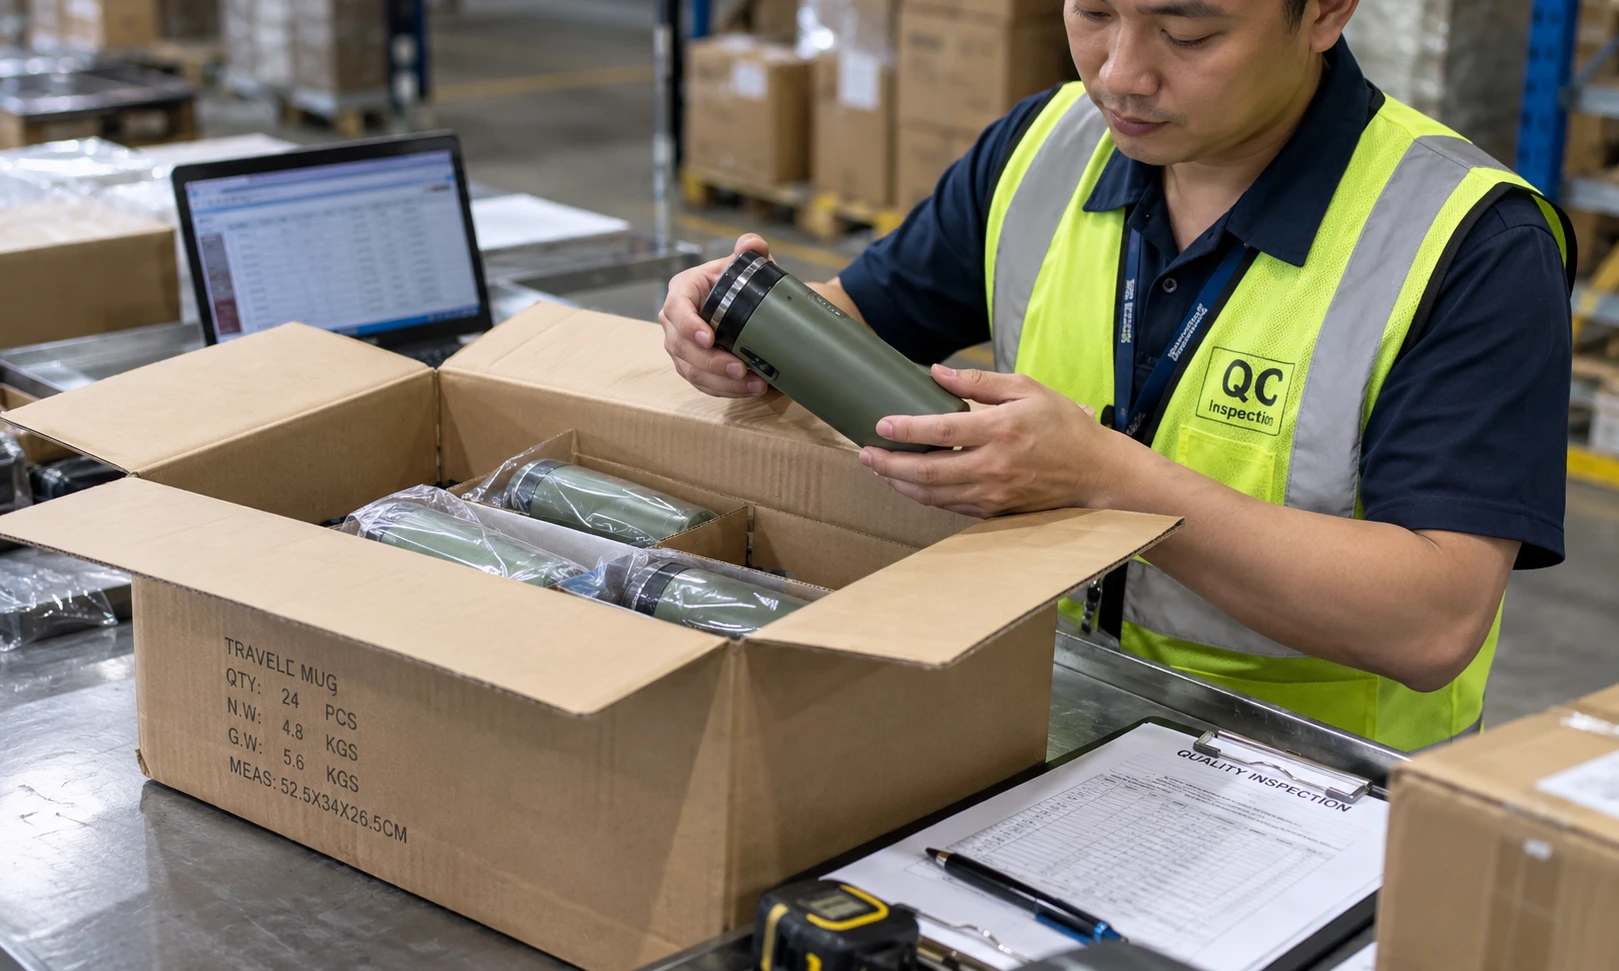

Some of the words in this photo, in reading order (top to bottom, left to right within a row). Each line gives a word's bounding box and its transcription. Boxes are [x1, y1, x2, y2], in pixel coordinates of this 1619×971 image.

[1222, 359, 1283, 407] QC
[226, 668, 261, 695] QTY:
[282, 688, 299, 709] 24
[325, 704, 357, 730] PCS
[227, 697, 262, 724] N.W:
[282, 719, 304, 740] 4.8
[325, 734, 358, 762] KGS
[228, 727, 263, 755] G.W:
[283, 748, 305, 771] 5.6
[326, 765, 359, 793] KGS
[1177, 749, 1248, 775] QUALITY
[1248, 773, 1352, 813] INSPECTION
[229, 756, 277, 790] MEAS:
[281, 777, 407, 844] 52.5X34X26.5CM
